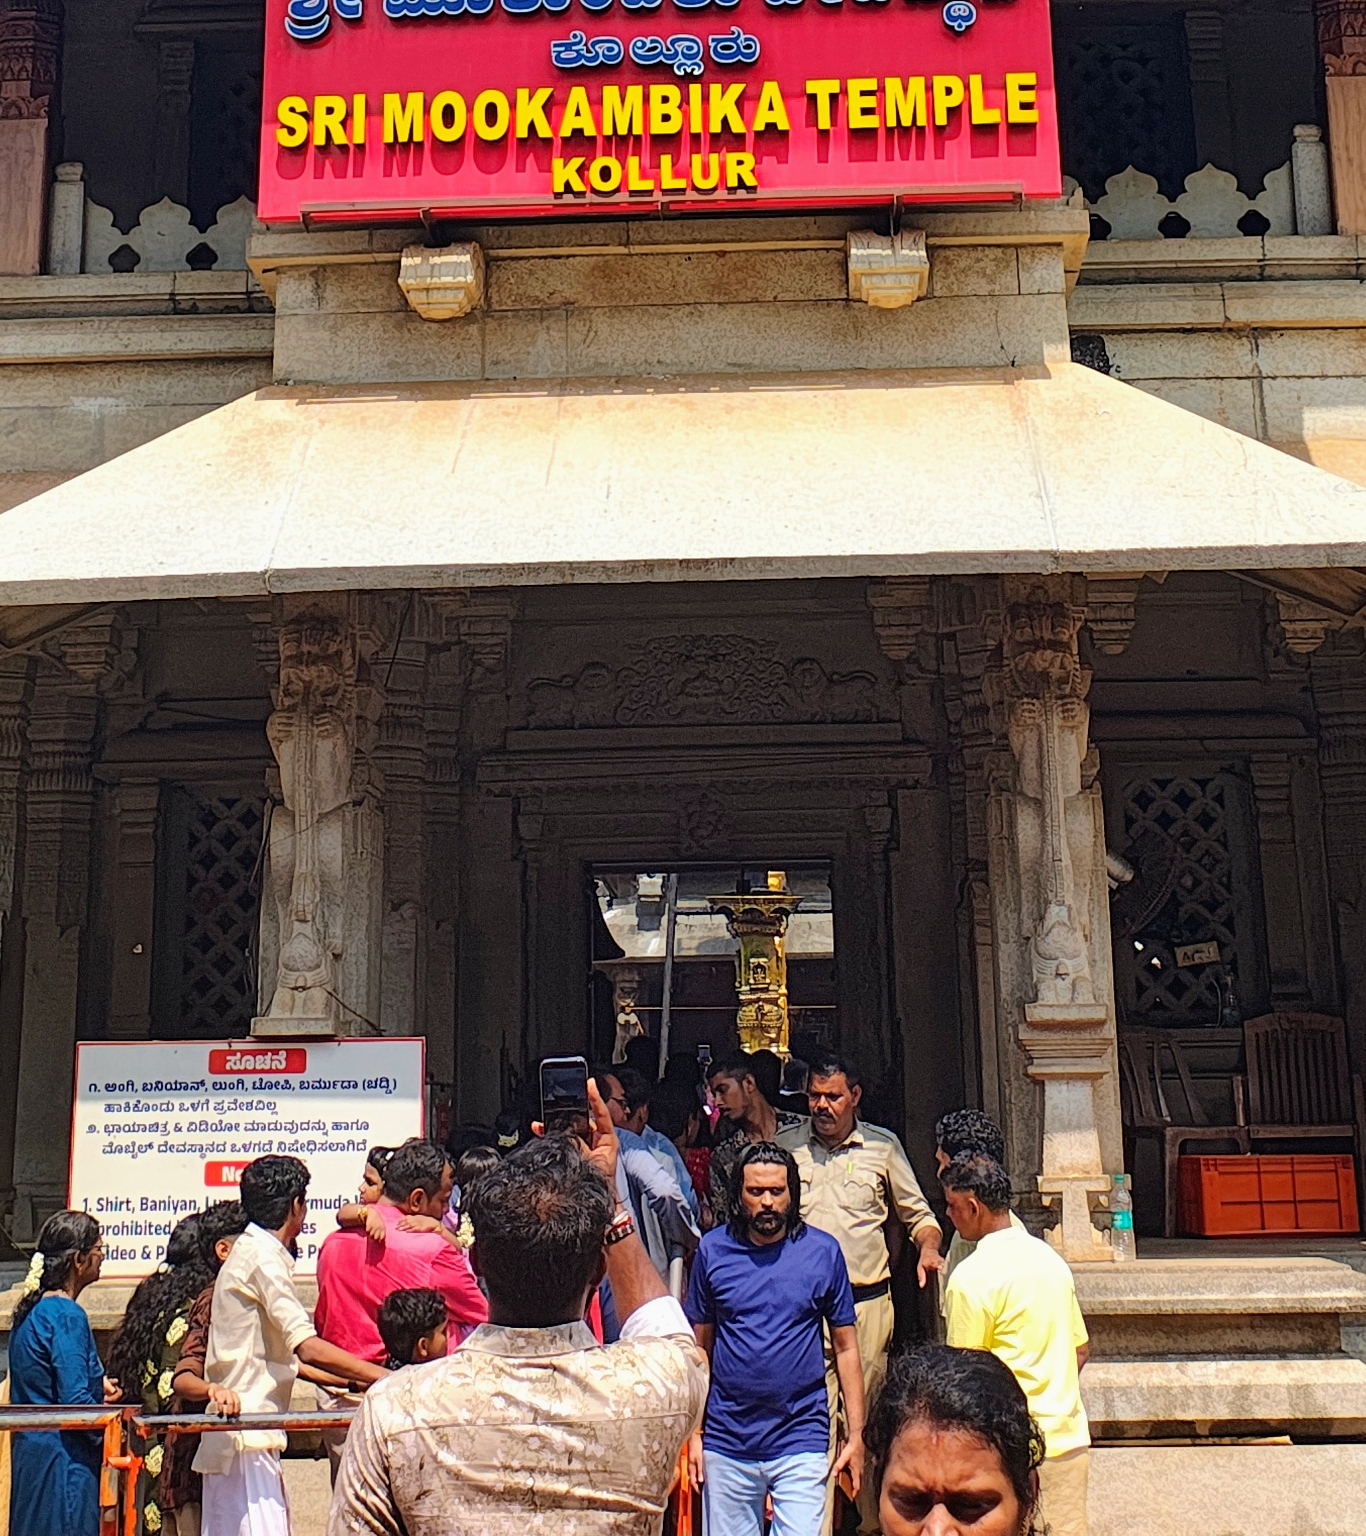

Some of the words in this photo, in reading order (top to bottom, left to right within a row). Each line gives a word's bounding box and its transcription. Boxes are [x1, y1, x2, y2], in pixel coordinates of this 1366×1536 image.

[550, 26, 761, 76] ಕೊಲ್ಲೂರು
[275, 94, 367, 148] SRI
[382, 81, 791, 144] MOOKAMBIKA
[806, 71, 1040, 130] TEMPLE
[551, 151, 759, 197] KOLLUR
[225, 1049, 288, 1071] ಸೂಚನೆ
[104, 1079, 139, 1094] ಅಂಗಿ,
[211, 1079, 248, 1093] ಲುಂಗಿ,
[251, 1076, 296, 1092] ಟೋಪಿ,
[178, 1099, 211, 1113] ಒಳಗೆ
[173, 1121, 183, 1133] &
[331, 1119, 370, 1132] ಹಾಗೂ
[229, 1139, 274, 1154] ಒಳಗಡೆ
[82, 1197, 93, 1213] 1.
[95, 1197, 136, 1214] Shirt,
[139, 1195, 201, 1215] Baniyan,
[105, 1245, 136, 1261] ideo
[140, 1245, 152, 1260] &
